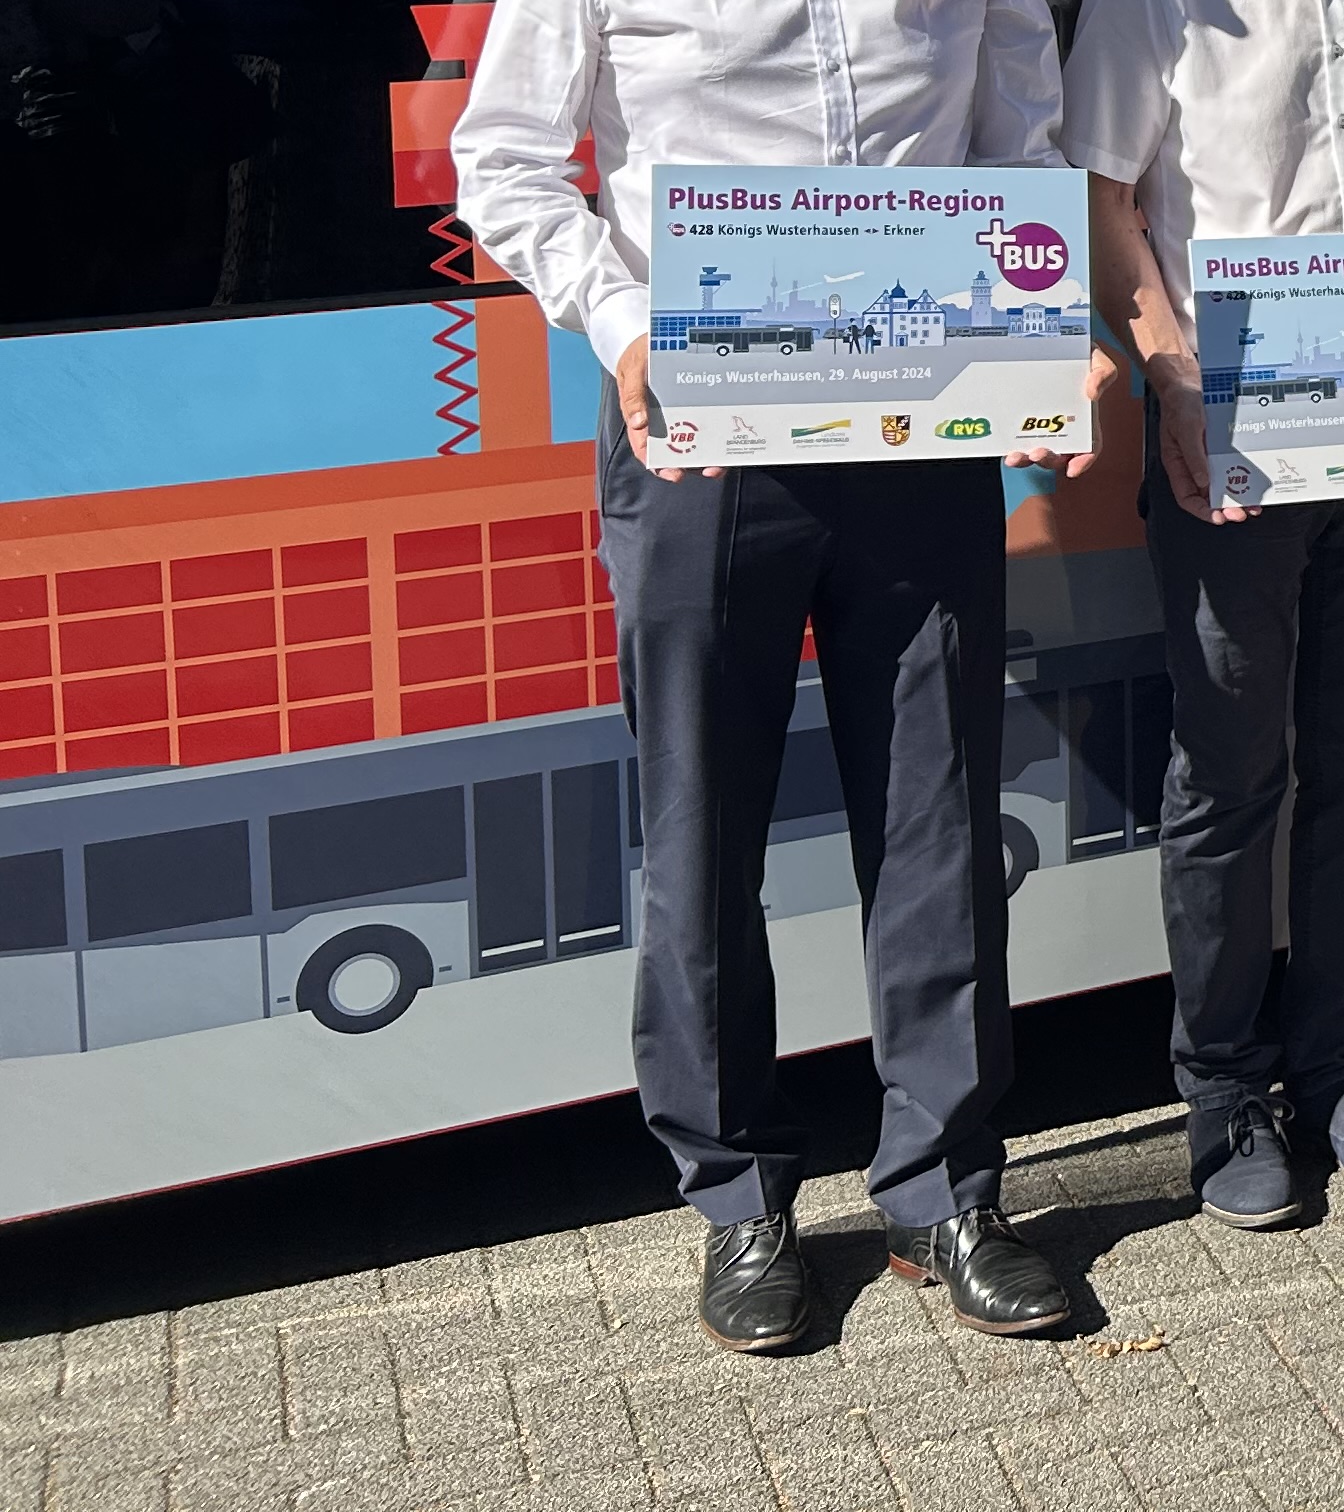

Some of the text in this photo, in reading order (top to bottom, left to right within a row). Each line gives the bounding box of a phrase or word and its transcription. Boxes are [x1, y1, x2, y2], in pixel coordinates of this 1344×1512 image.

[669, 187, 1004, 217] PlusBus Airport-Region
[689, 225, 714, 235] 428
[718, 224, 762, 238] Königs
[766, 224, 859, 236] Wusterhausen
[884, 225, 925, 236] Erkner
[1206, 257, 1300, 278] PlusBus
[1226, 290, 1246, 301] 428
[1249, 288, 1286, 302] Königs
[676, 367, 932, 386] Königs Wusterhausen, 29. August 2024
[953, 423, 985, 436] RVS
[671, 433, 695, 443] VBB
[1228, 475, 1248, 485] VBB
